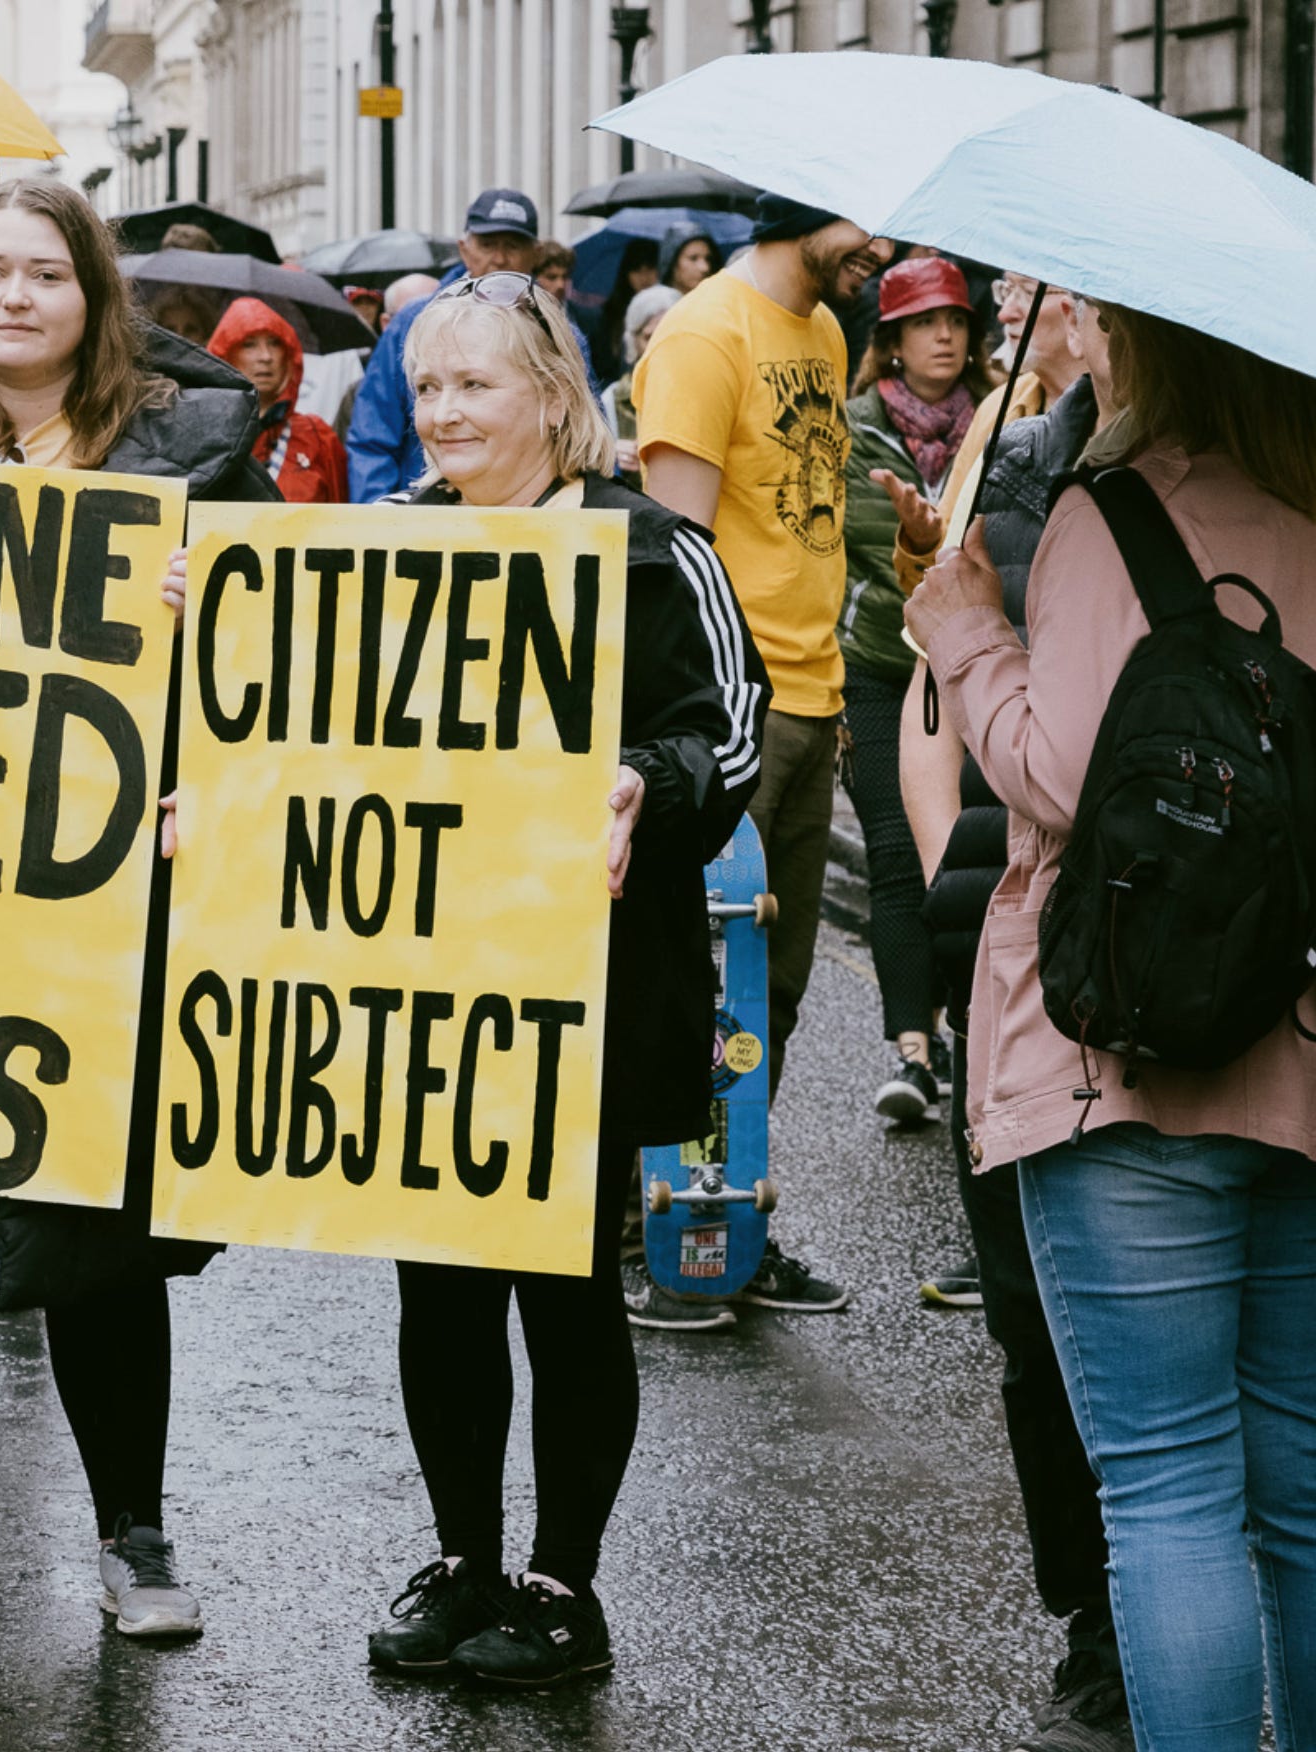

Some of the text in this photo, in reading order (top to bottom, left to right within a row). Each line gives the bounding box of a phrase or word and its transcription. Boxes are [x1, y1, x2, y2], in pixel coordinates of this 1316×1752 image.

[198, 543, 600, 754] CITIZEN
[281, 793, 463, 938] NOT
[736, 1036, 757, 1048] NOT
[736, 1047, 752, 1057] MY
[729, 1056, 755, 1069] KING
[171, 969, 586, 1201] SUBJECT
[695, 1231, 717, 1246] ONE
[686, 1248, 699, 1262] IS
